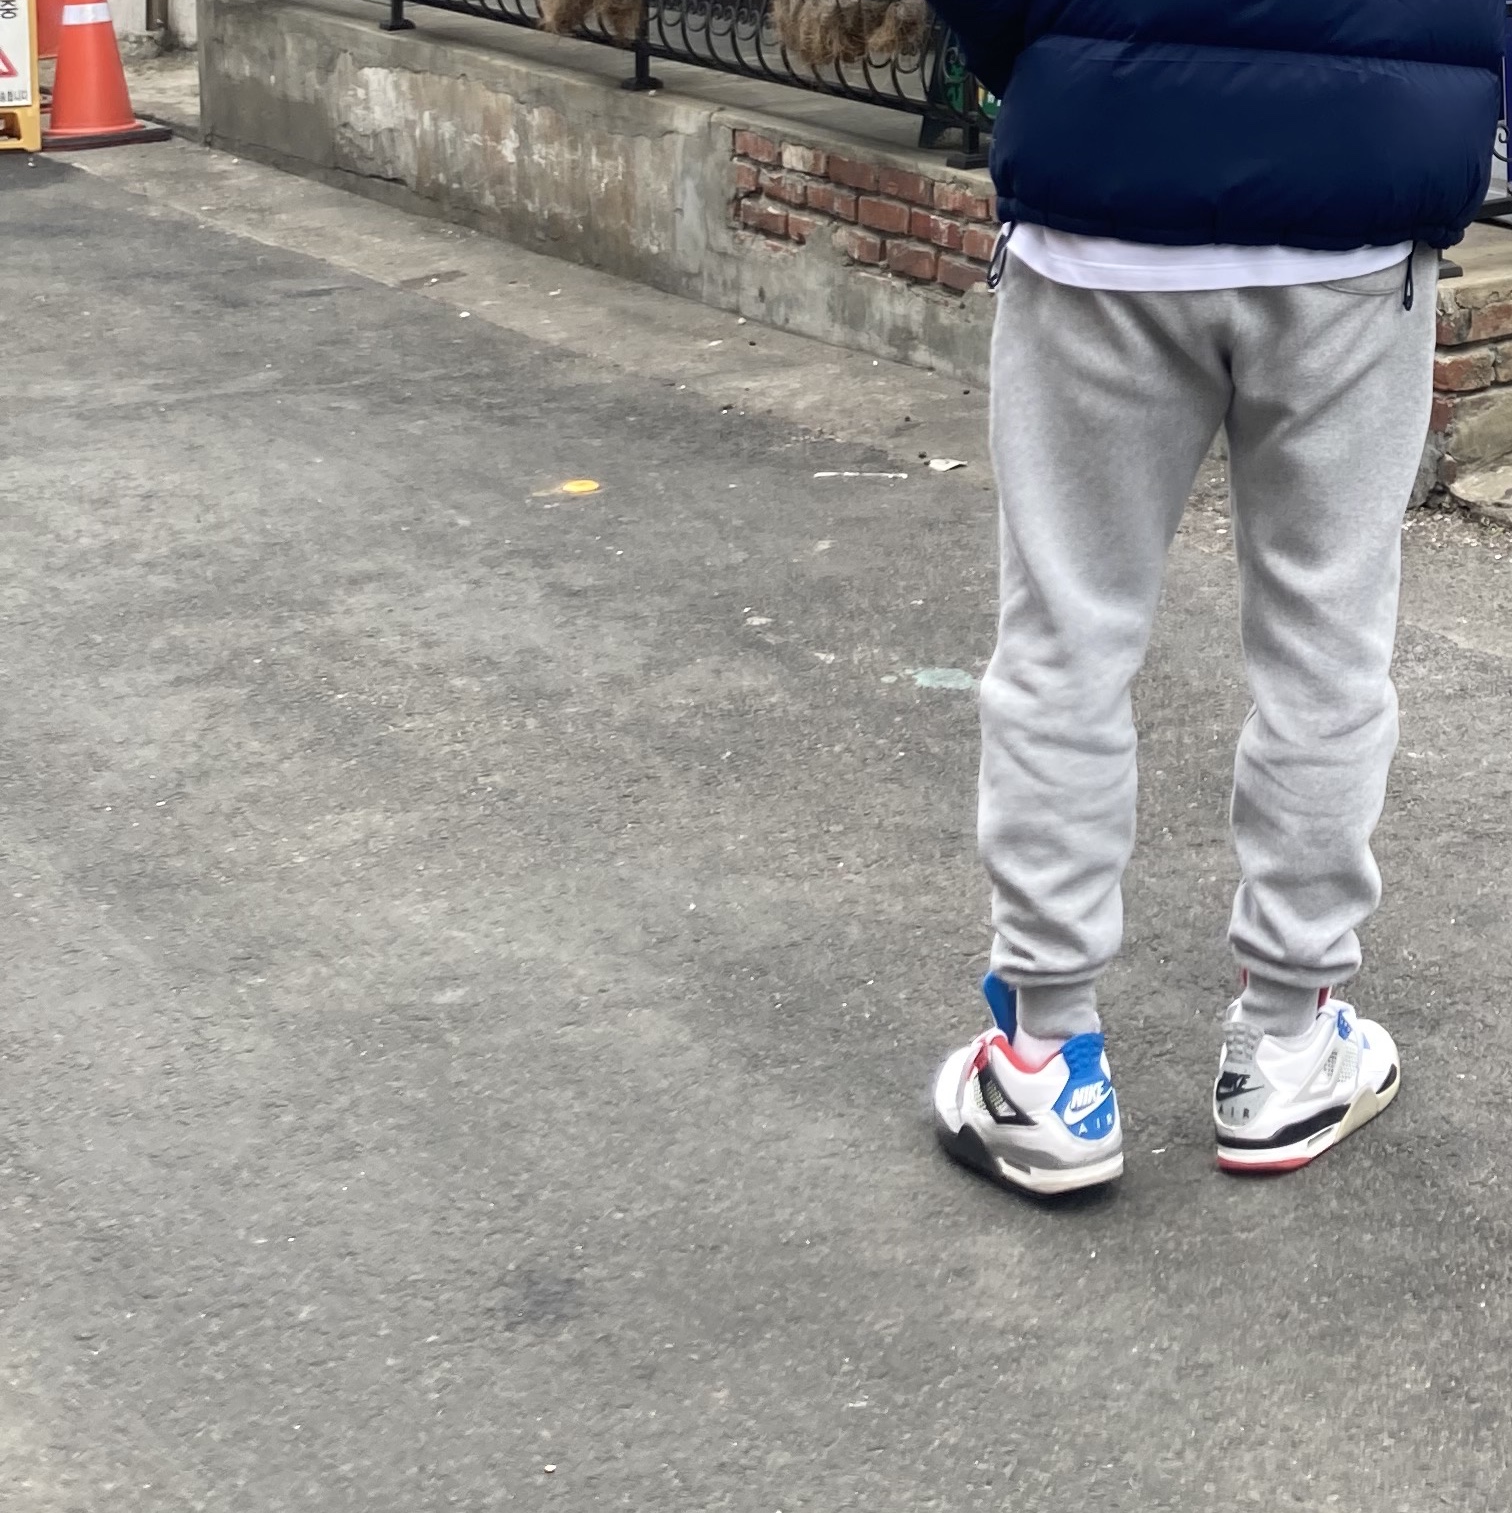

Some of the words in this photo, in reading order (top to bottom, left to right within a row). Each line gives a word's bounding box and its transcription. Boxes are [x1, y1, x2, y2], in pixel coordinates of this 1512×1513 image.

[1070, 1080, 1104, 1110] NIKE
[1218, 1104, 1250, 1119] AIR
[1078, 1112, 1113, 1135] AIR
